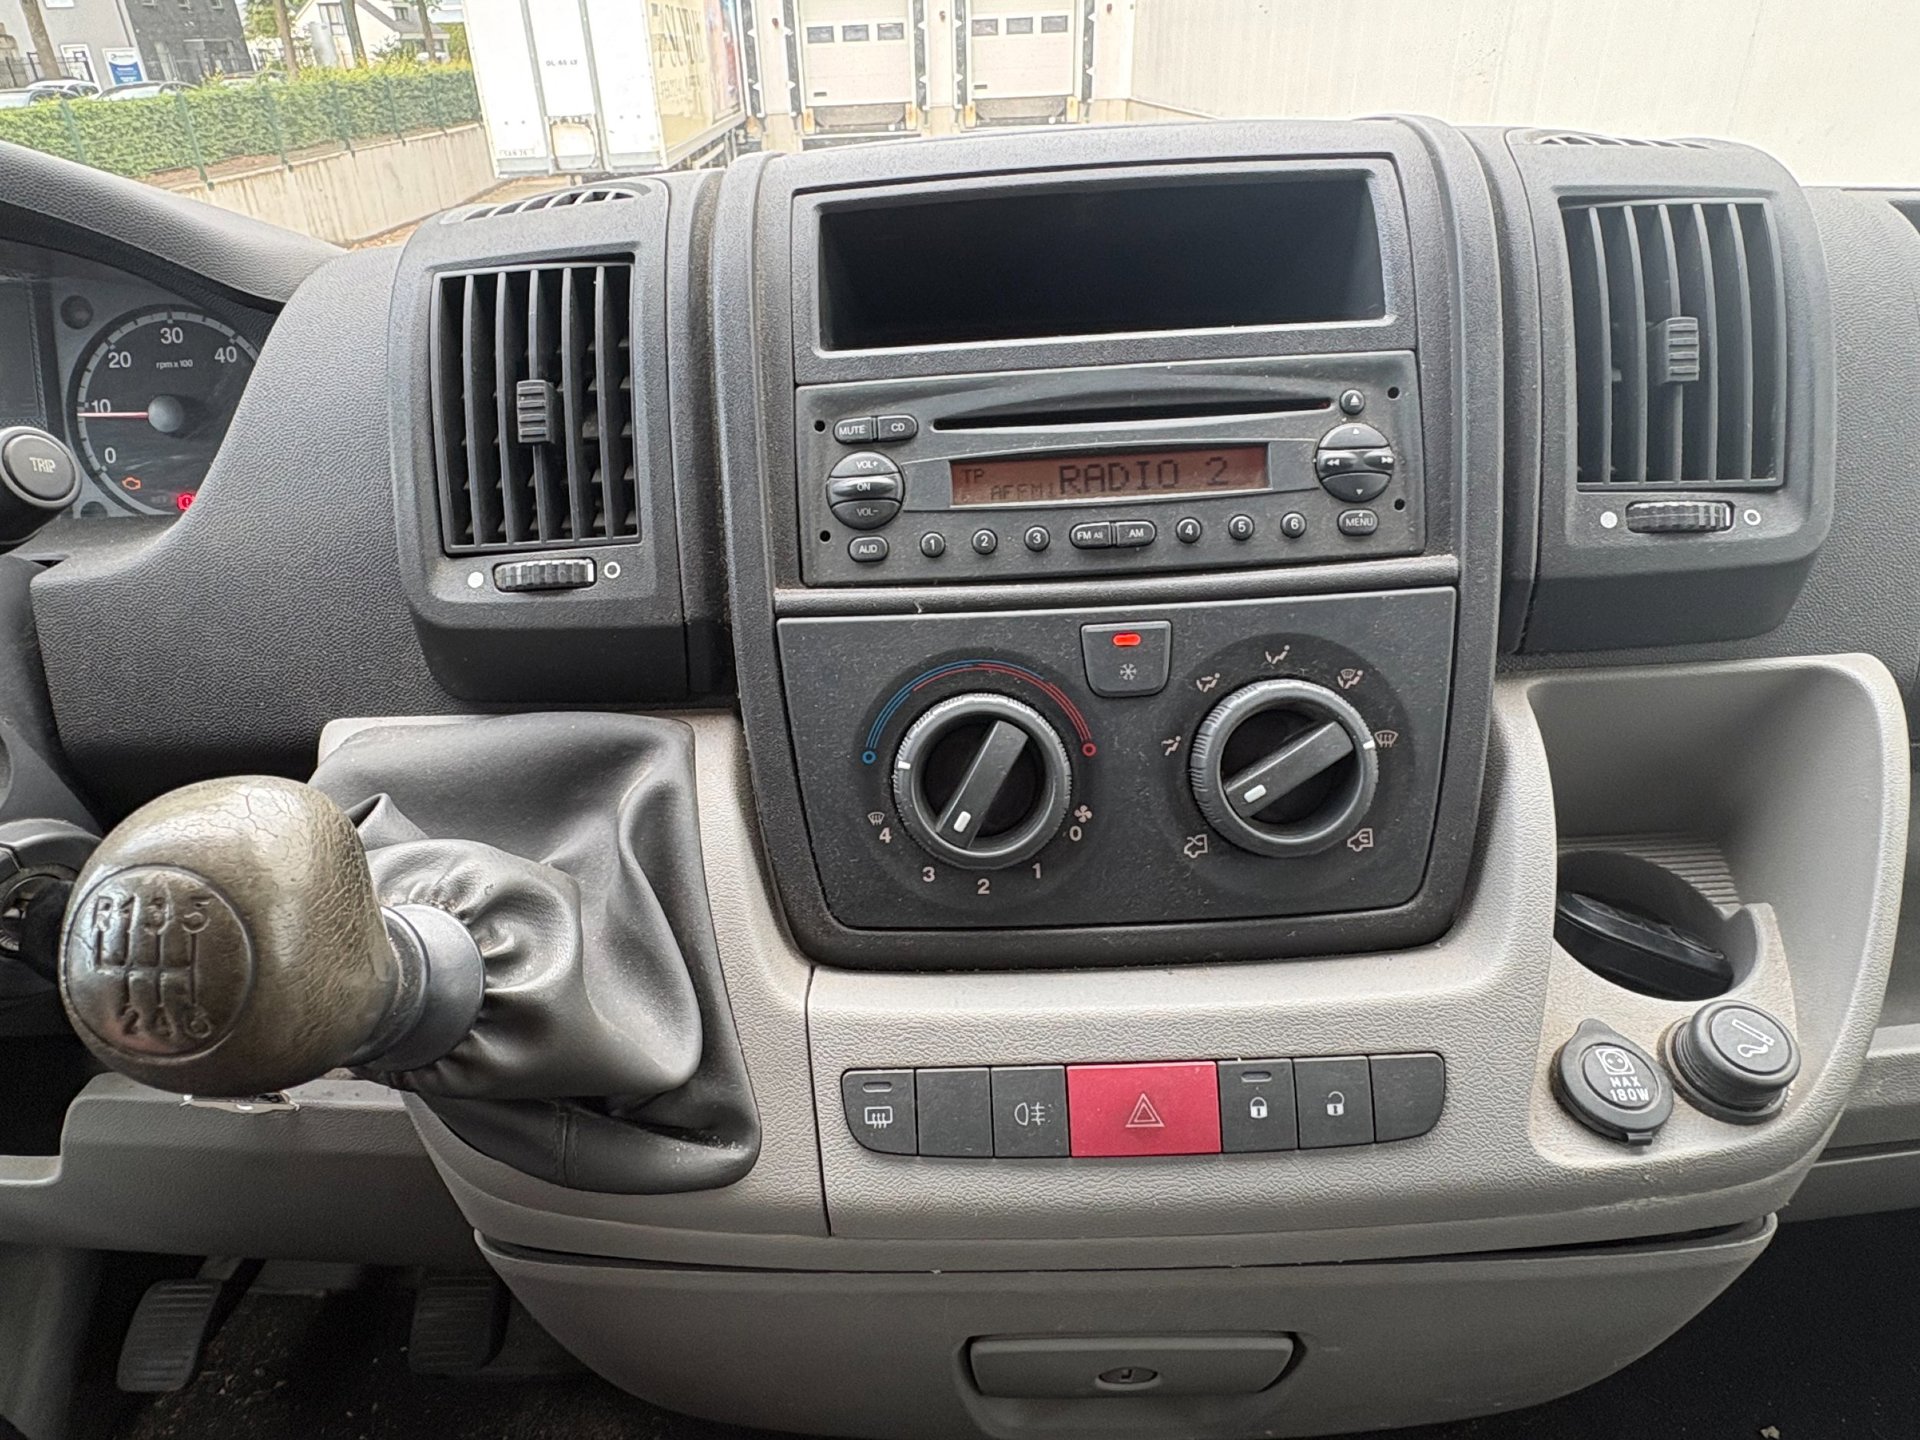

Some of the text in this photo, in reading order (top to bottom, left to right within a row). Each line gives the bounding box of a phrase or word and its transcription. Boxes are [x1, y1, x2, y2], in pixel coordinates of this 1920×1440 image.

[160, 327, 183, 344] 30
[108, 352, 131, 368] 20
[214, 346, 237, 363] 40
[156, 360, 173, 369] rpm
[180, 359, 193, 368] 100
[91, 399, 111, 413] 10
[839, 425, 866, 436] MUTE
[891, 423, 905, 432] CD
[104, 447, 116, 464] 0
[30, 457, 56, 473] TRIP
[856, 461, 879, 469] VOL+
[961, 468, 985, 484] TP
[1059, 457, 1229, 495] RADIO 2
[857, 482, 871, 491] ON
[856, 508, 879, 517] VOL-
[1238, 521, 1246, 533] 5
[1290, 518, 1298, 530] 6
[1345, 517, 1373, 527] MENU
[1077, 531, 1091, 541] FM
[1128, 528, 1144, 538] AM
[1185, 525, 1193, 535] 4
[980, 536, 988, 546] 2
[1033, 533, 1041, 543] 3
[858, 545, 878, 554] AUD
[929, 539, 936, 550] 1
[879, 827, 892, 843] 4
[1069, 825, 1082, 841] 0
[922, 866, 935, 882] 3
[1032, 863, 1041, 879] 1
[977, 878, 990, 894] 2
[92, 895, 114, 932] R
[182, 896, 217, 933] 5
[118, 1006, 140, 1035] 2
[1610, 1075, 1641, 1087] MAX
[1610, 1087, 1649, 1102] 180W
